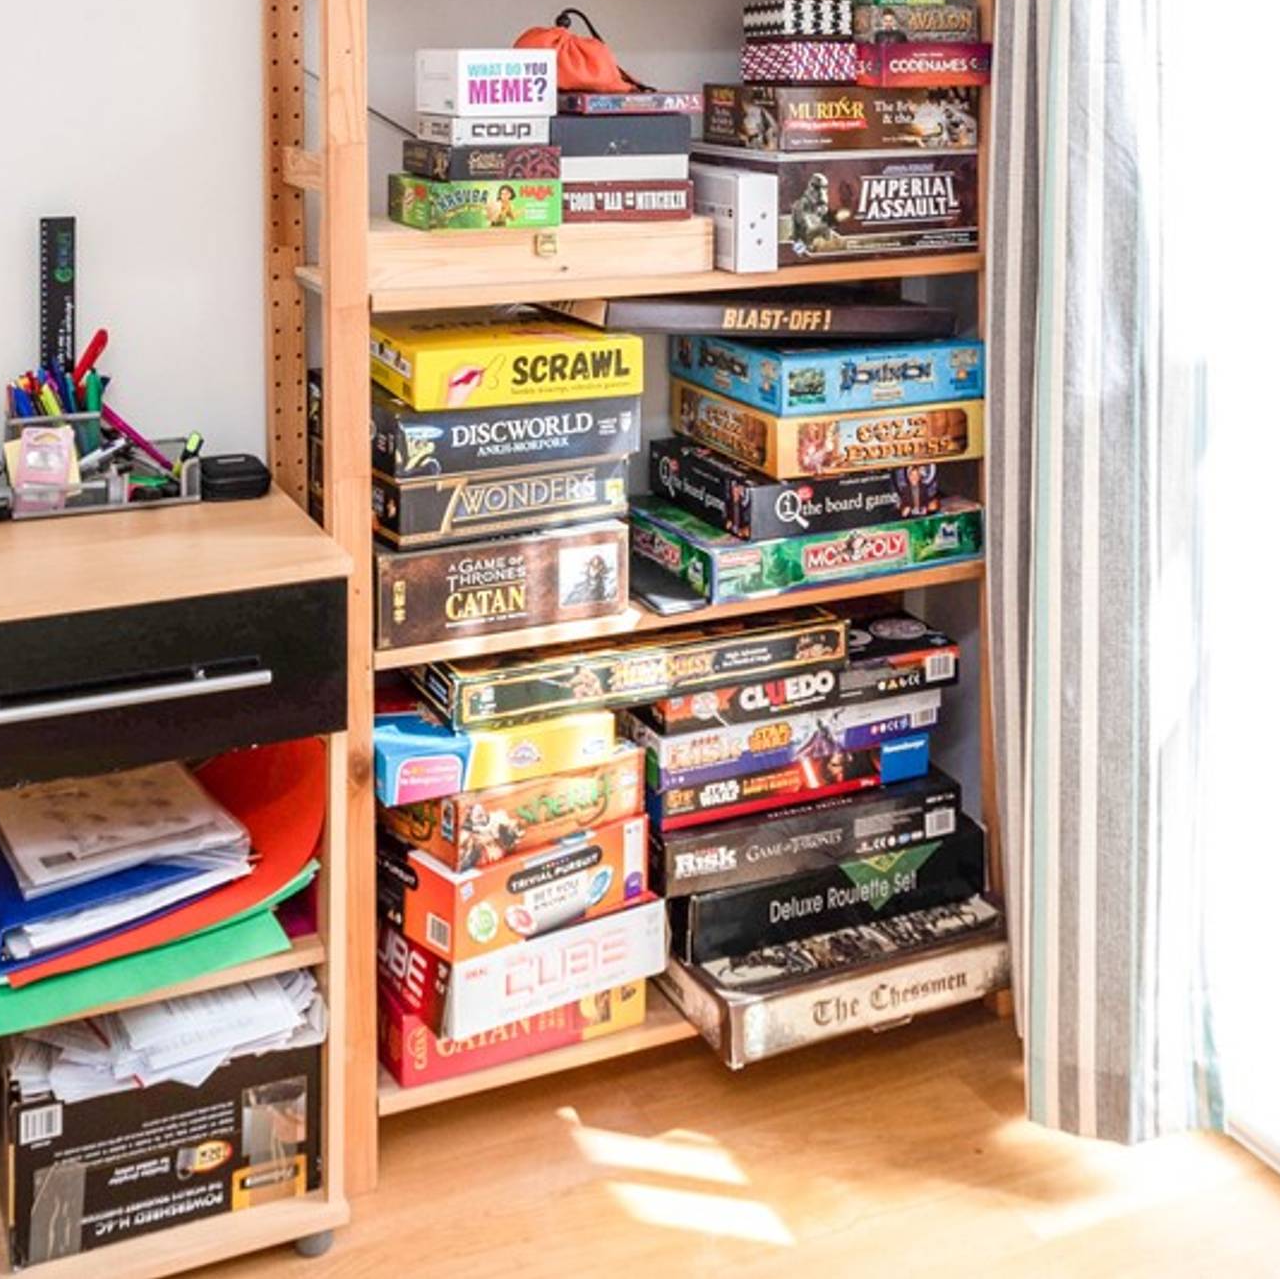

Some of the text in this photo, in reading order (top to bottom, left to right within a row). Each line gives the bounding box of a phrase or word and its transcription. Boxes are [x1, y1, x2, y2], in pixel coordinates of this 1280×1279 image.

[468, 61, 548, 77] WHAT DO YOU
[889, 58, 968, 73] CODENAMES
[468, 77, 548, 105] MEME?
[858, 176, 959, 214] IMPERIAL
[867, 198, 948, 220] ASSAULT
[722, 309, 832, 330] BLAST-OFF!
[512, 349, 631, 386] SCRAWL
[450, 412, 594, 449] DISCWORLD
[857, 416, 928, 442] COLT
[477, 436, 569, 457] ANKH-MORPORK
[843, 436, 954, 463] EXPRESS
[437, 474, 596, 534] 7 WONDERS
[803, 501, 822, 516] the
[825, 492, 862, 513] board
[865, 492, 901, 511] game
[448, 563, 457, 573] A
[458, 557, 507, 573] GAME
[446, 565, 526, 593] THRONES
[445, 586, 526, 621] CATAN
[739, 671, 836, 710] CLUEDO
[754, 723, 791, 740] STAR
[699, 790, 738, 808] WARS
[704, 780, 739, 796] STAR
[746, 844, 782, 862] GAME
[790, 829, 843, 854] THRONES
[512, 870, 553, 892] TRIVIAL
[770, 870, 918, 923] Deluxe Roulette Set
[813, 969, 969, 1026] The Chessmen
